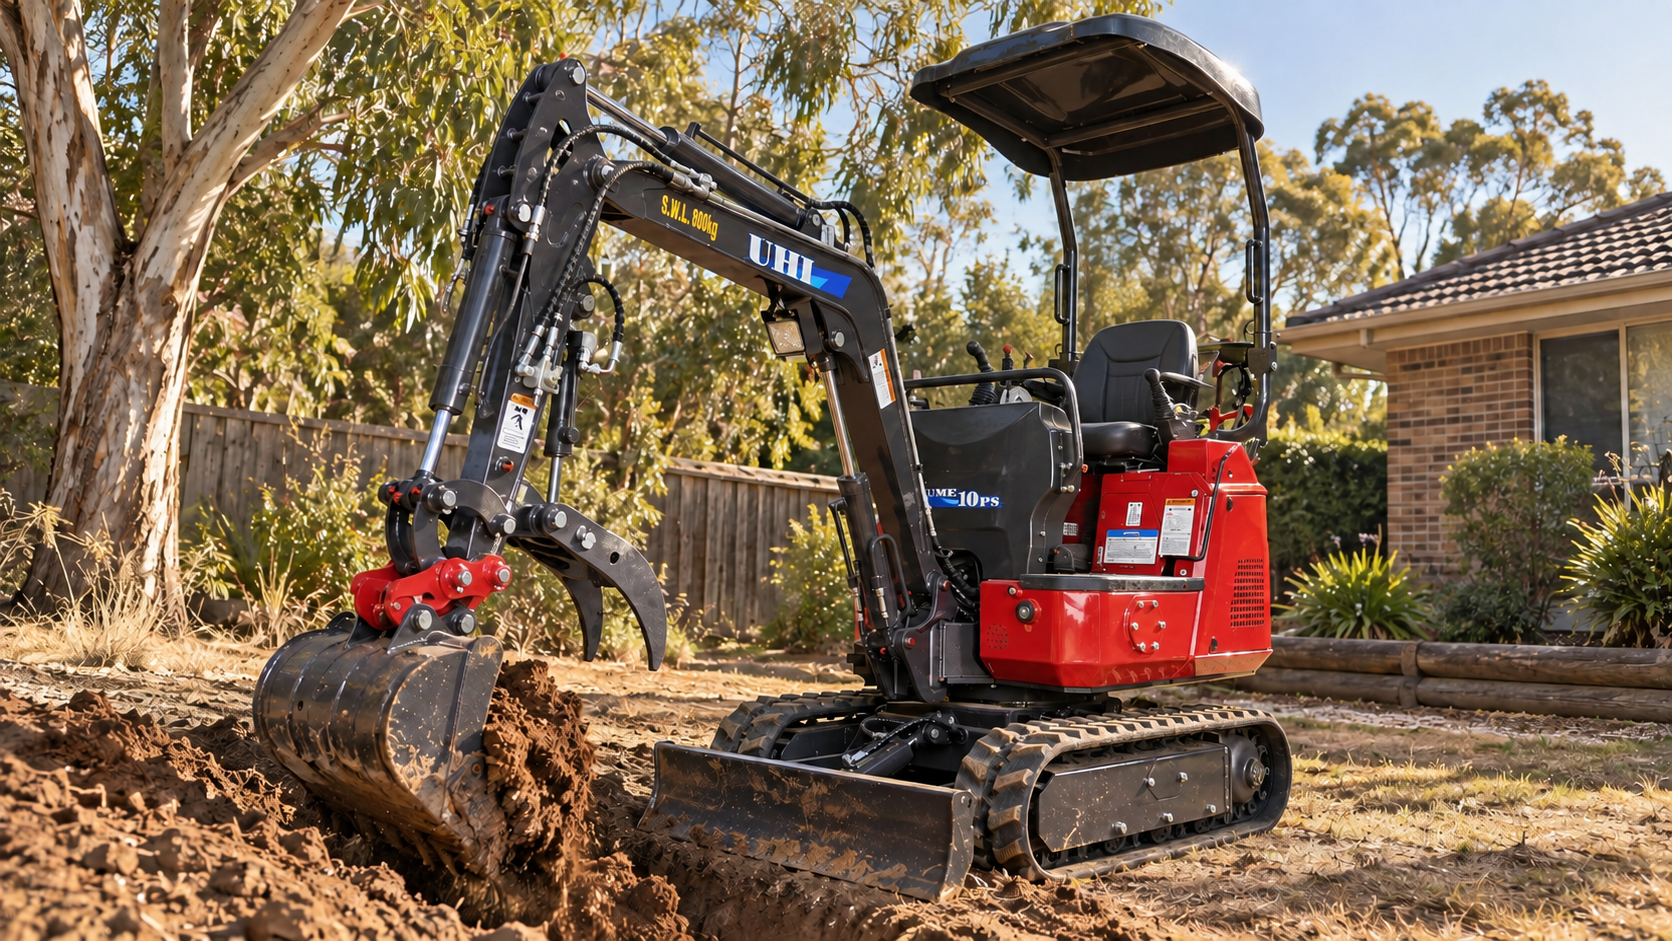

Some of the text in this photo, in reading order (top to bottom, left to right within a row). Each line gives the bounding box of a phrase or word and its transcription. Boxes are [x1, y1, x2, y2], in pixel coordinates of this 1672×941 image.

[661, 195, 718, 242] S.W.L. 800kg
[748, 232, 814, 285] UHI
